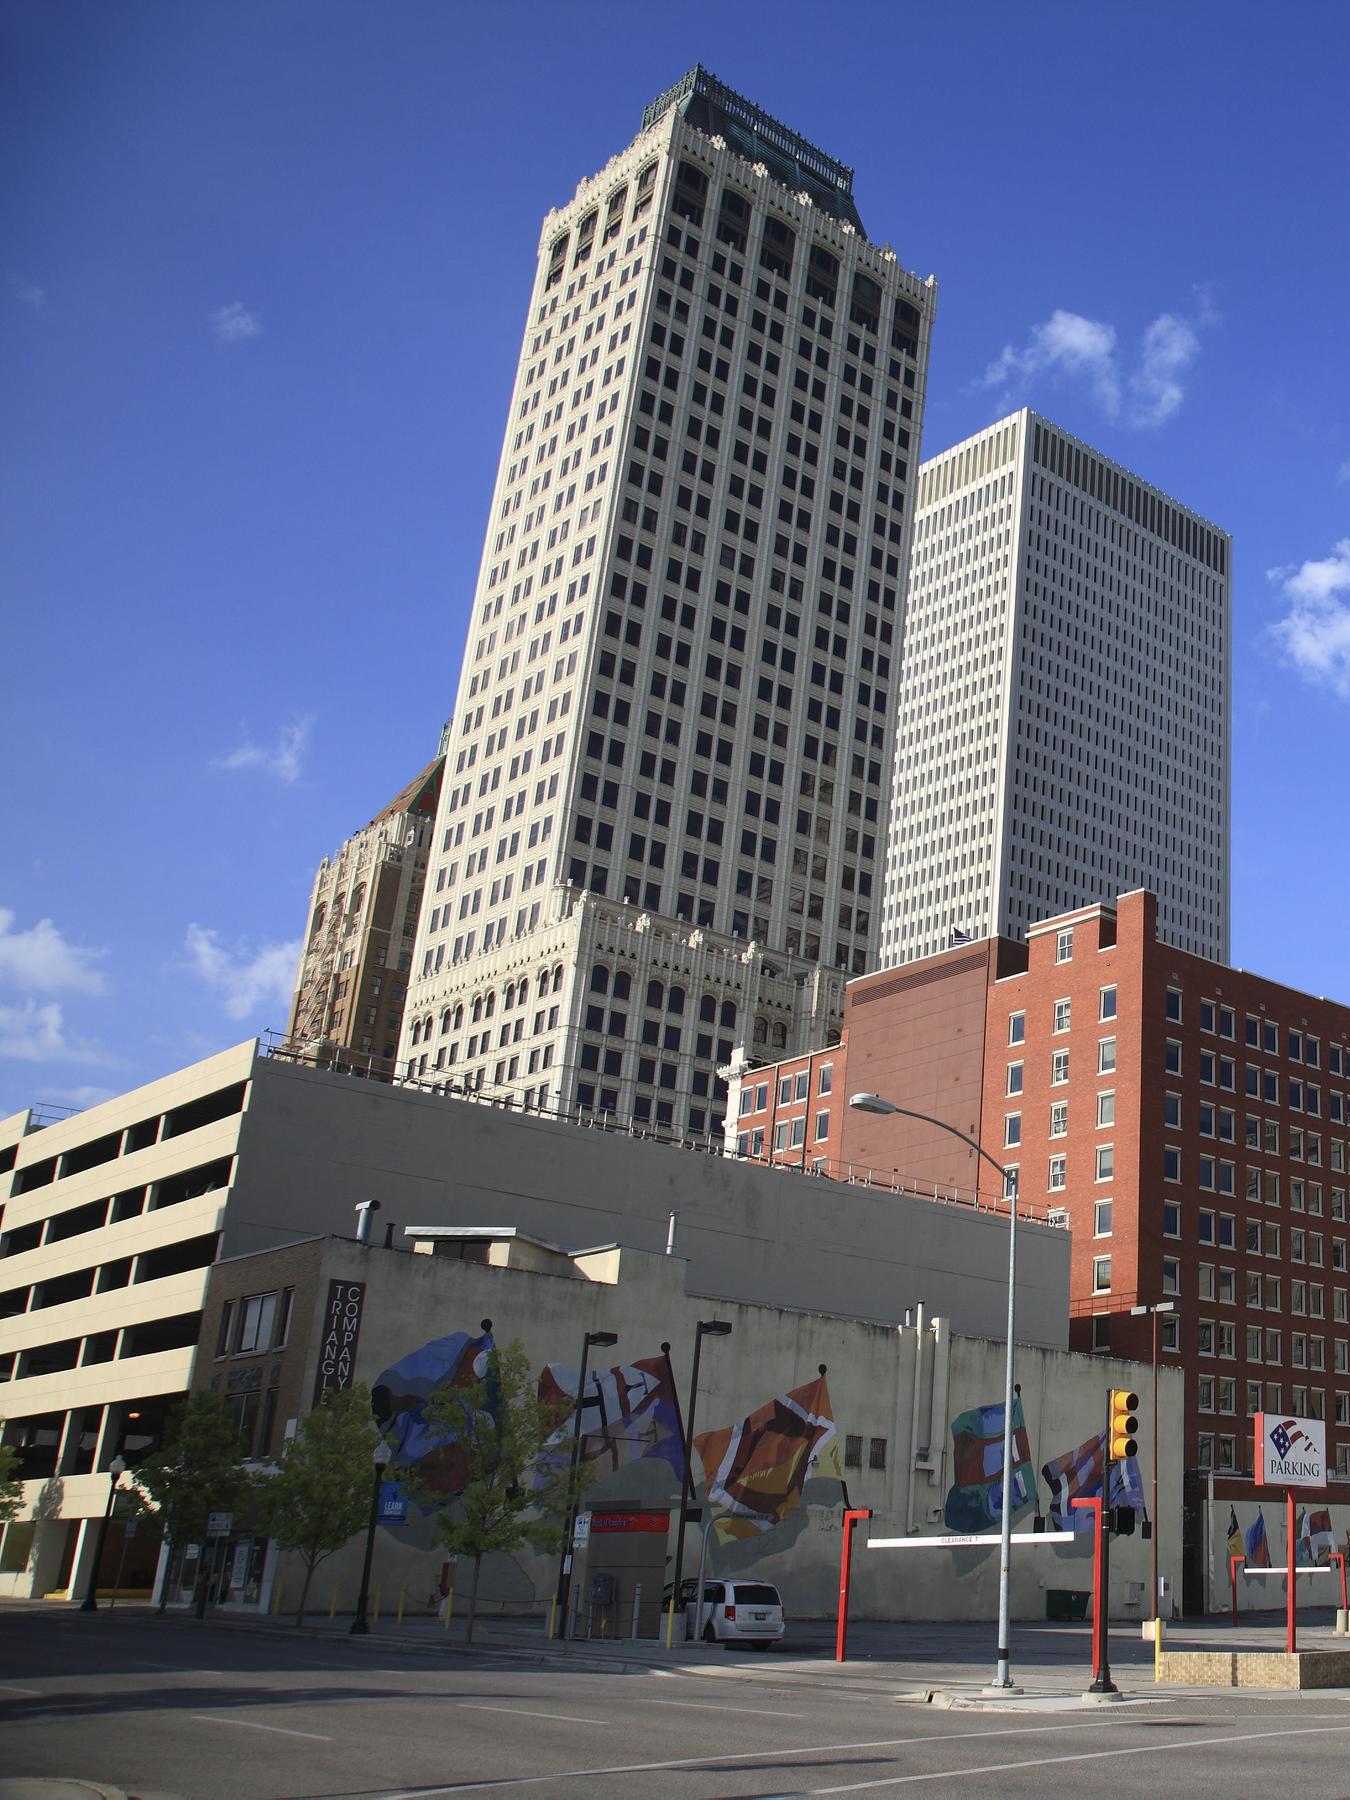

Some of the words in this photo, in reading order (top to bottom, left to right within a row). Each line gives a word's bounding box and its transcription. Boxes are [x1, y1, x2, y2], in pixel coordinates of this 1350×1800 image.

[338, 1287, 360, 1390] COMPANY
[1270, 1459, 1320, 1477] PARKING
[941, 1536, 972, 1544] CLEARANCE
